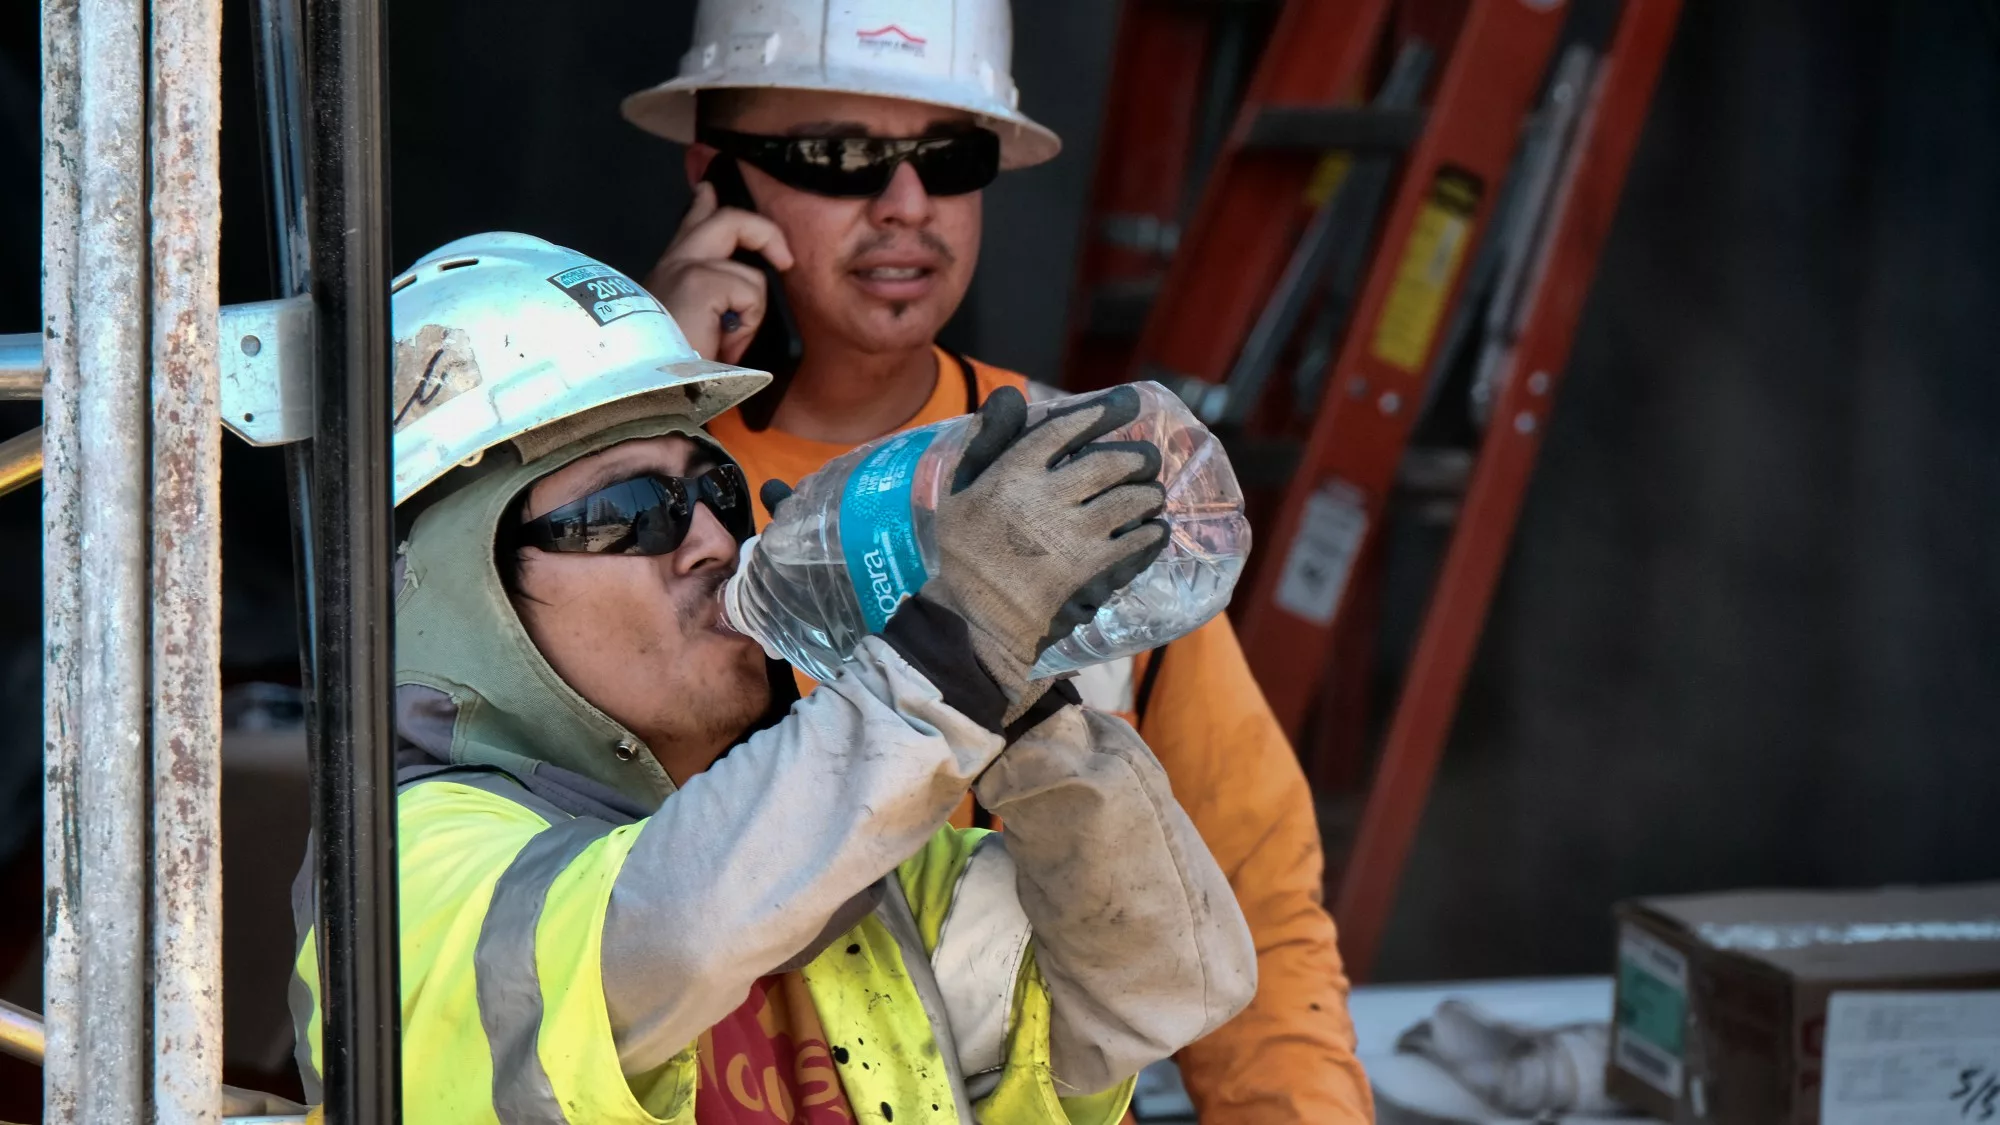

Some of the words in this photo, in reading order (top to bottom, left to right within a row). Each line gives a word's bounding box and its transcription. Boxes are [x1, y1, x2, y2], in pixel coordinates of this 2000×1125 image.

[586, 278, 635, 300] 2018
[598, 304, 613, 315] 70
[863, 549, 912, 624] gara
